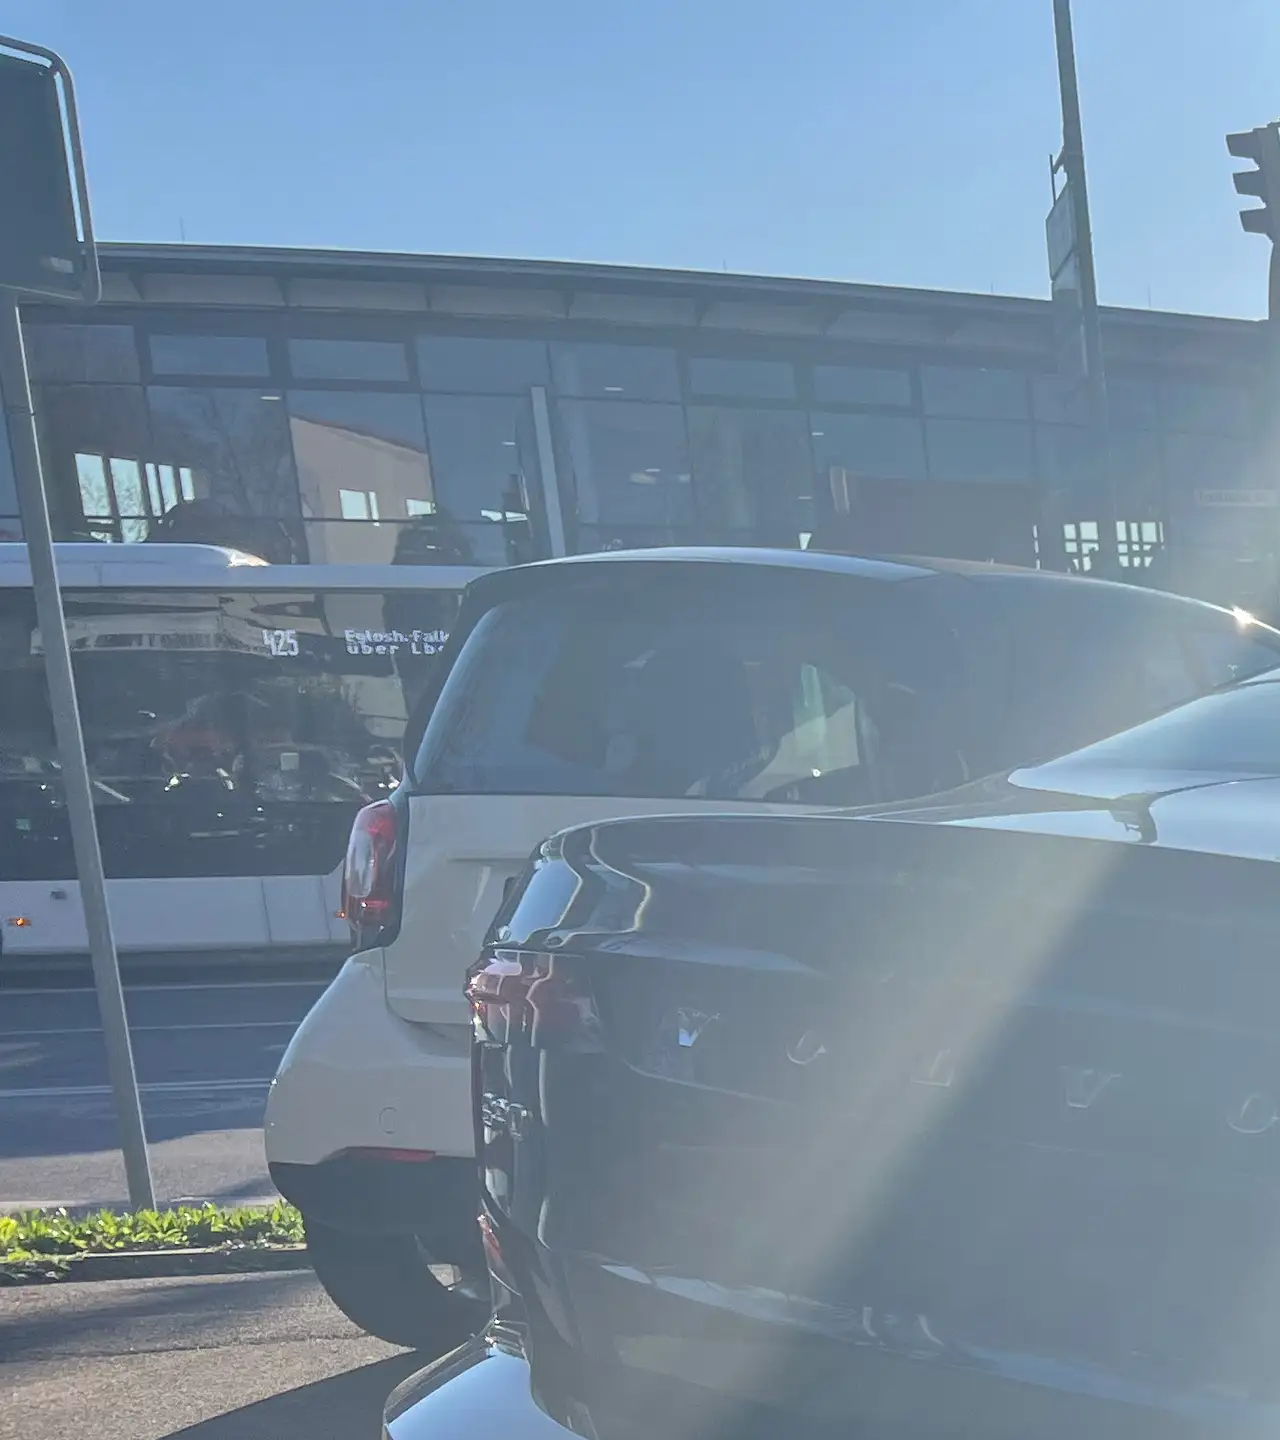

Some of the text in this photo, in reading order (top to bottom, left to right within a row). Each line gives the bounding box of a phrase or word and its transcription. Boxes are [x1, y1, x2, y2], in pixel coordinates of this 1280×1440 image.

[261, 629, 300, 656] 425
[346, 641, 400, 655] über
[678, 1006, 1280, 1134] VOLVO
